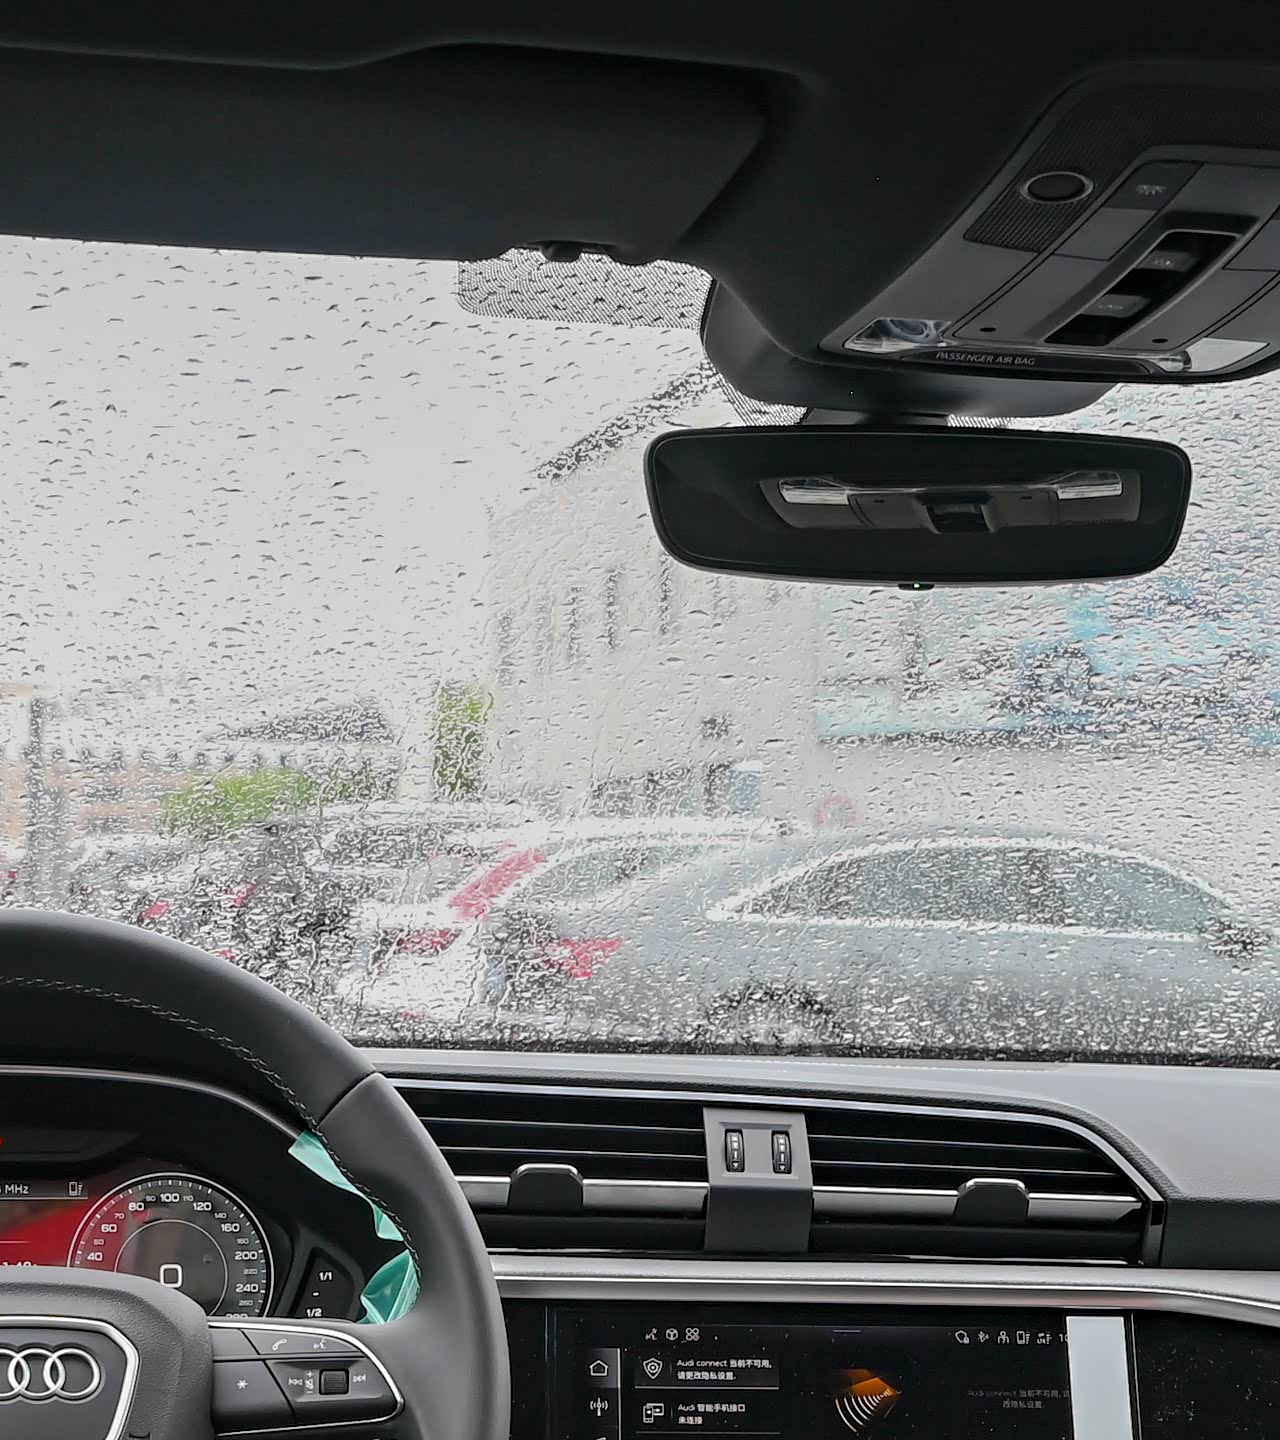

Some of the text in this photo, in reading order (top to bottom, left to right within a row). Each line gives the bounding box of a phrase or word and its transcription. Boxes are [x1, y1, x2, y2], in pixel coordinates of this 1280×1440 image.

[936, 351, 1036, 366] PASSENGER AIR BAG
[5, 1184, 29, 1195] MHz
[160, 1193, 180, 1203] 100
[128, 1202, 144, 1211] 80
[193, 1202, 212, 1211] 120
[101, 1223, 117, 1233] 60
[220, 1223, 240, 1233] 160
[87, 1252, 103, 1262] 40
[234, 1250, 258, 1260] 200
[160, 1264, 183, 1288] 0
[235, 1283, 258, 1293] 240
[676, 1359, 694, 1367] Audi
[696, 1360, 728, 1368] connect
[678, 1404, 695, 1412] Audi
